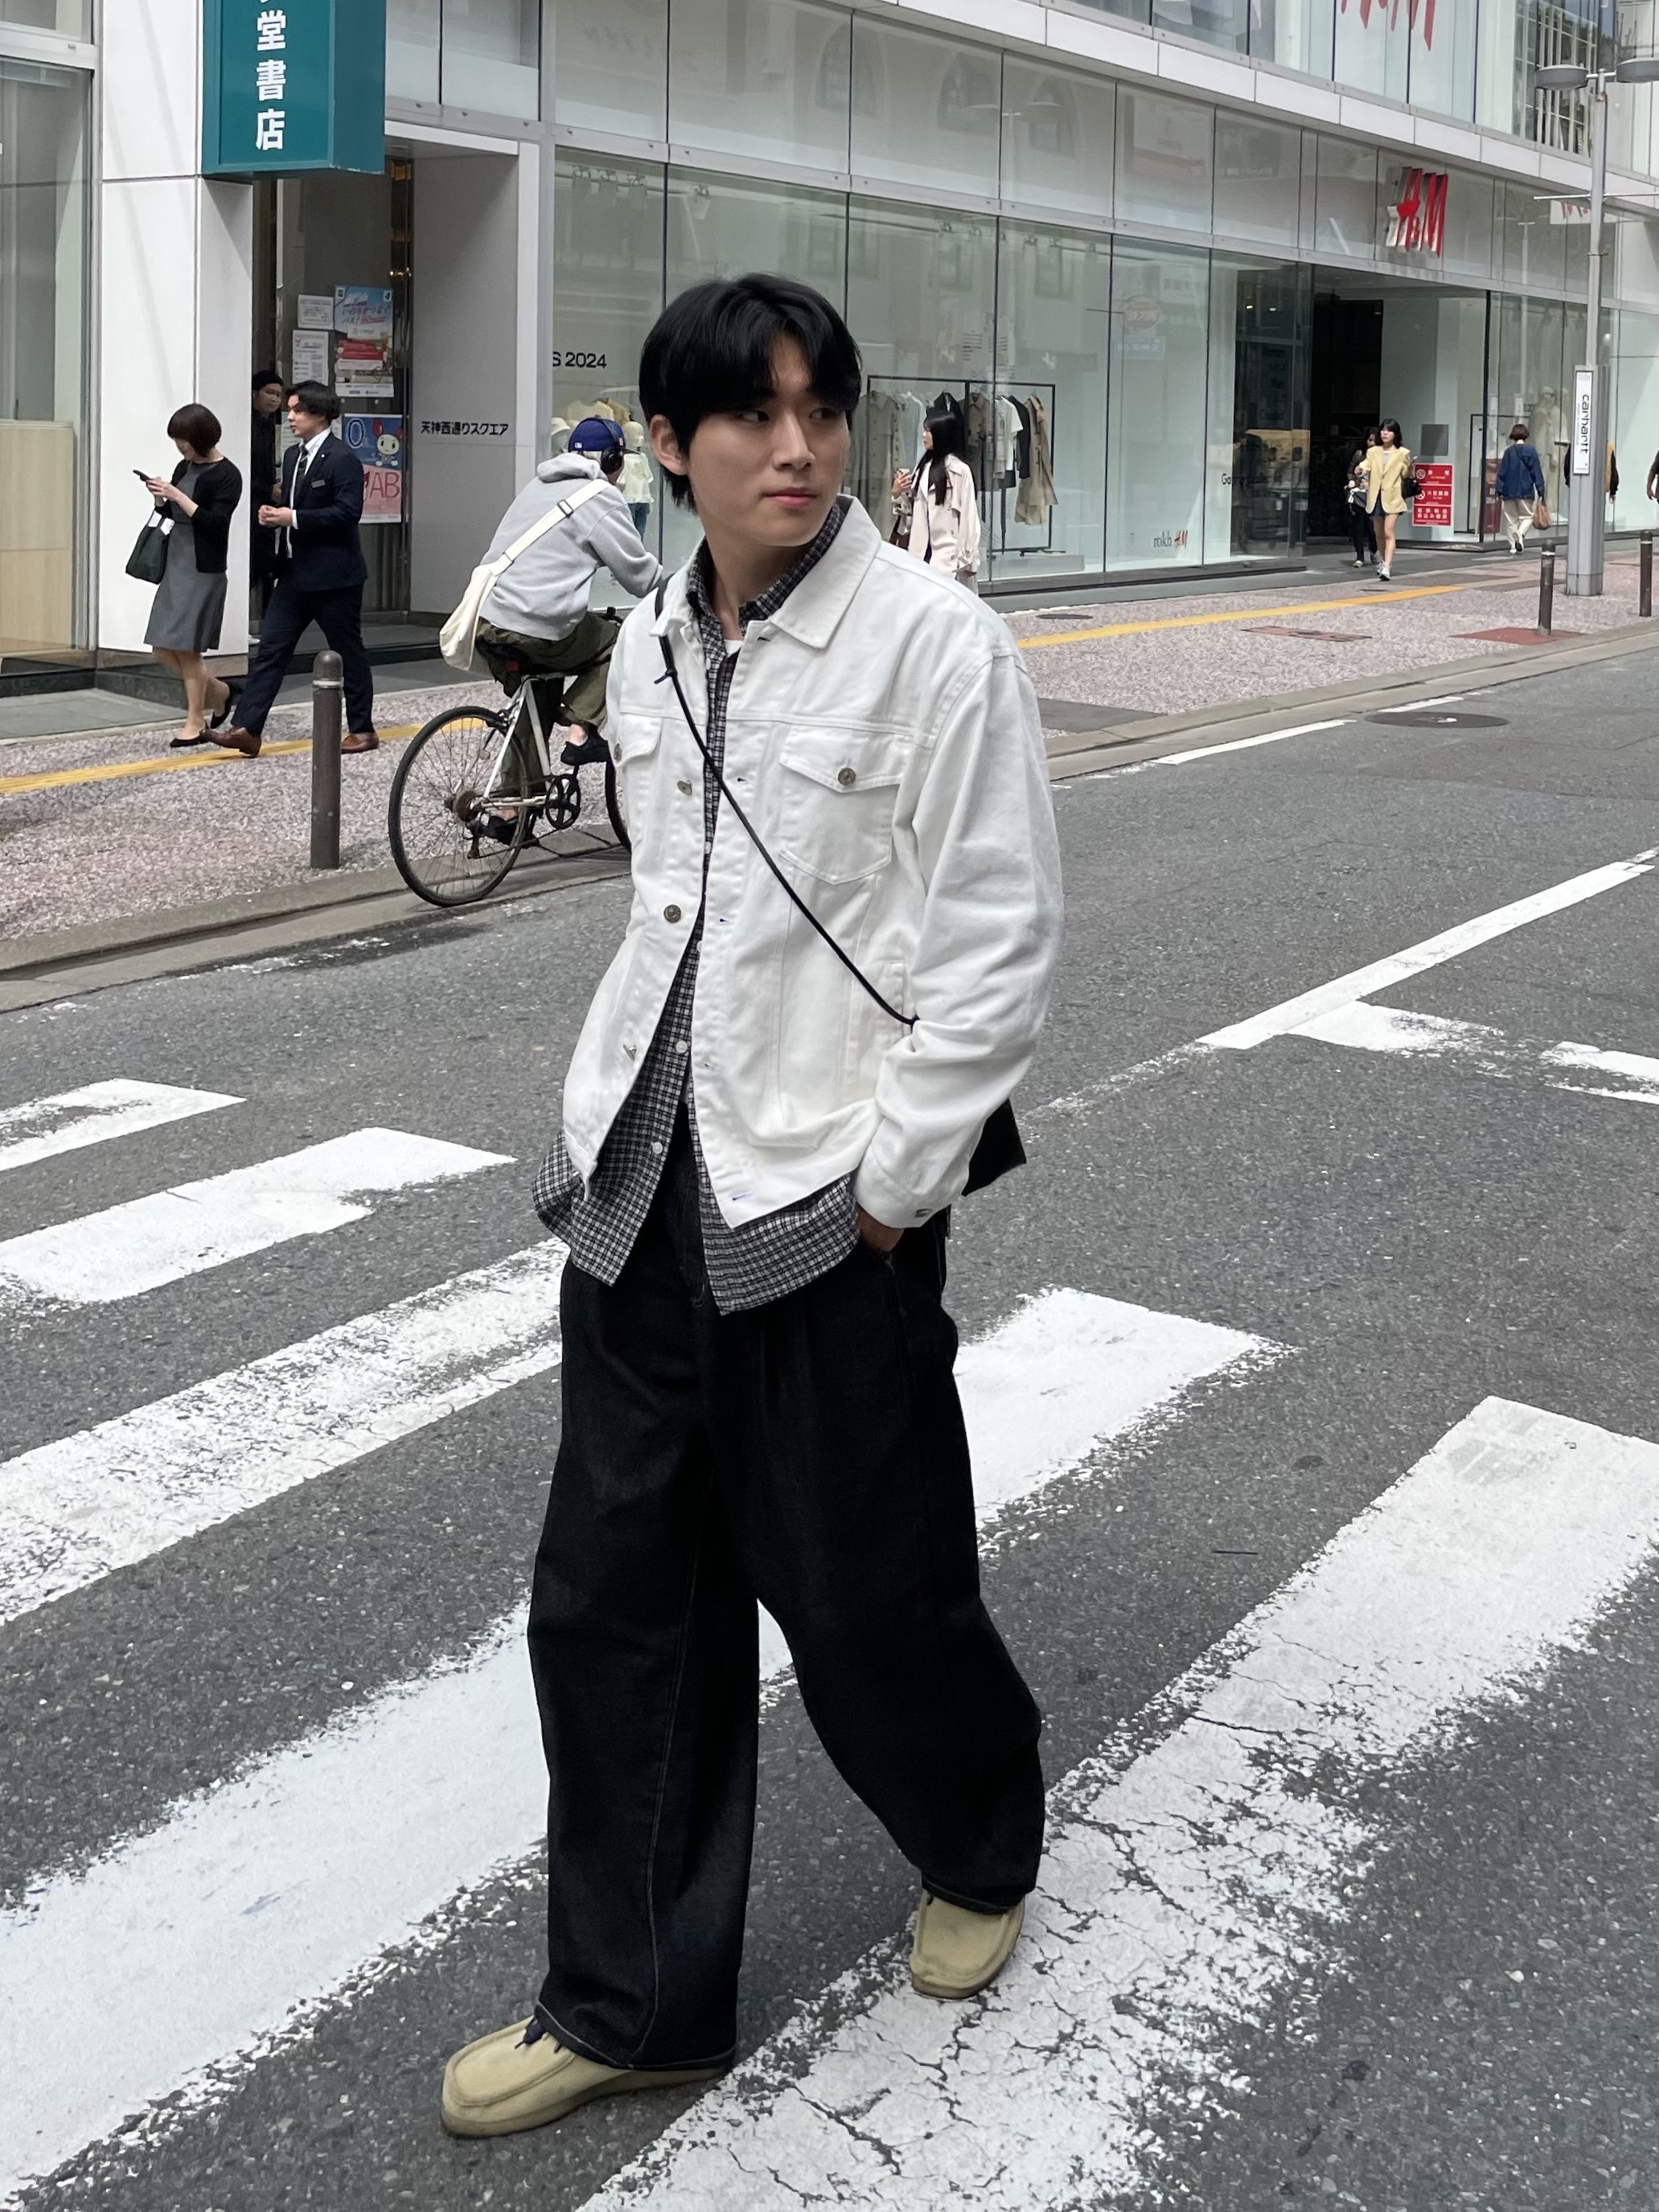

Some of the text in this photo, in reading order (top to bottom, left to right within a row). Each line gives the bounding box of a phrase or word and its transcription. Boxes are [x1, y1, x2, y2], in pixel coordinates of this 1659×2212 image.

[256, 0, 286, 150] 堂書店
[1389, 166, 1448, 258] H&M
[565, 351, 606, 368] 2024
[1580, 394, 1590, 453] carhartt
